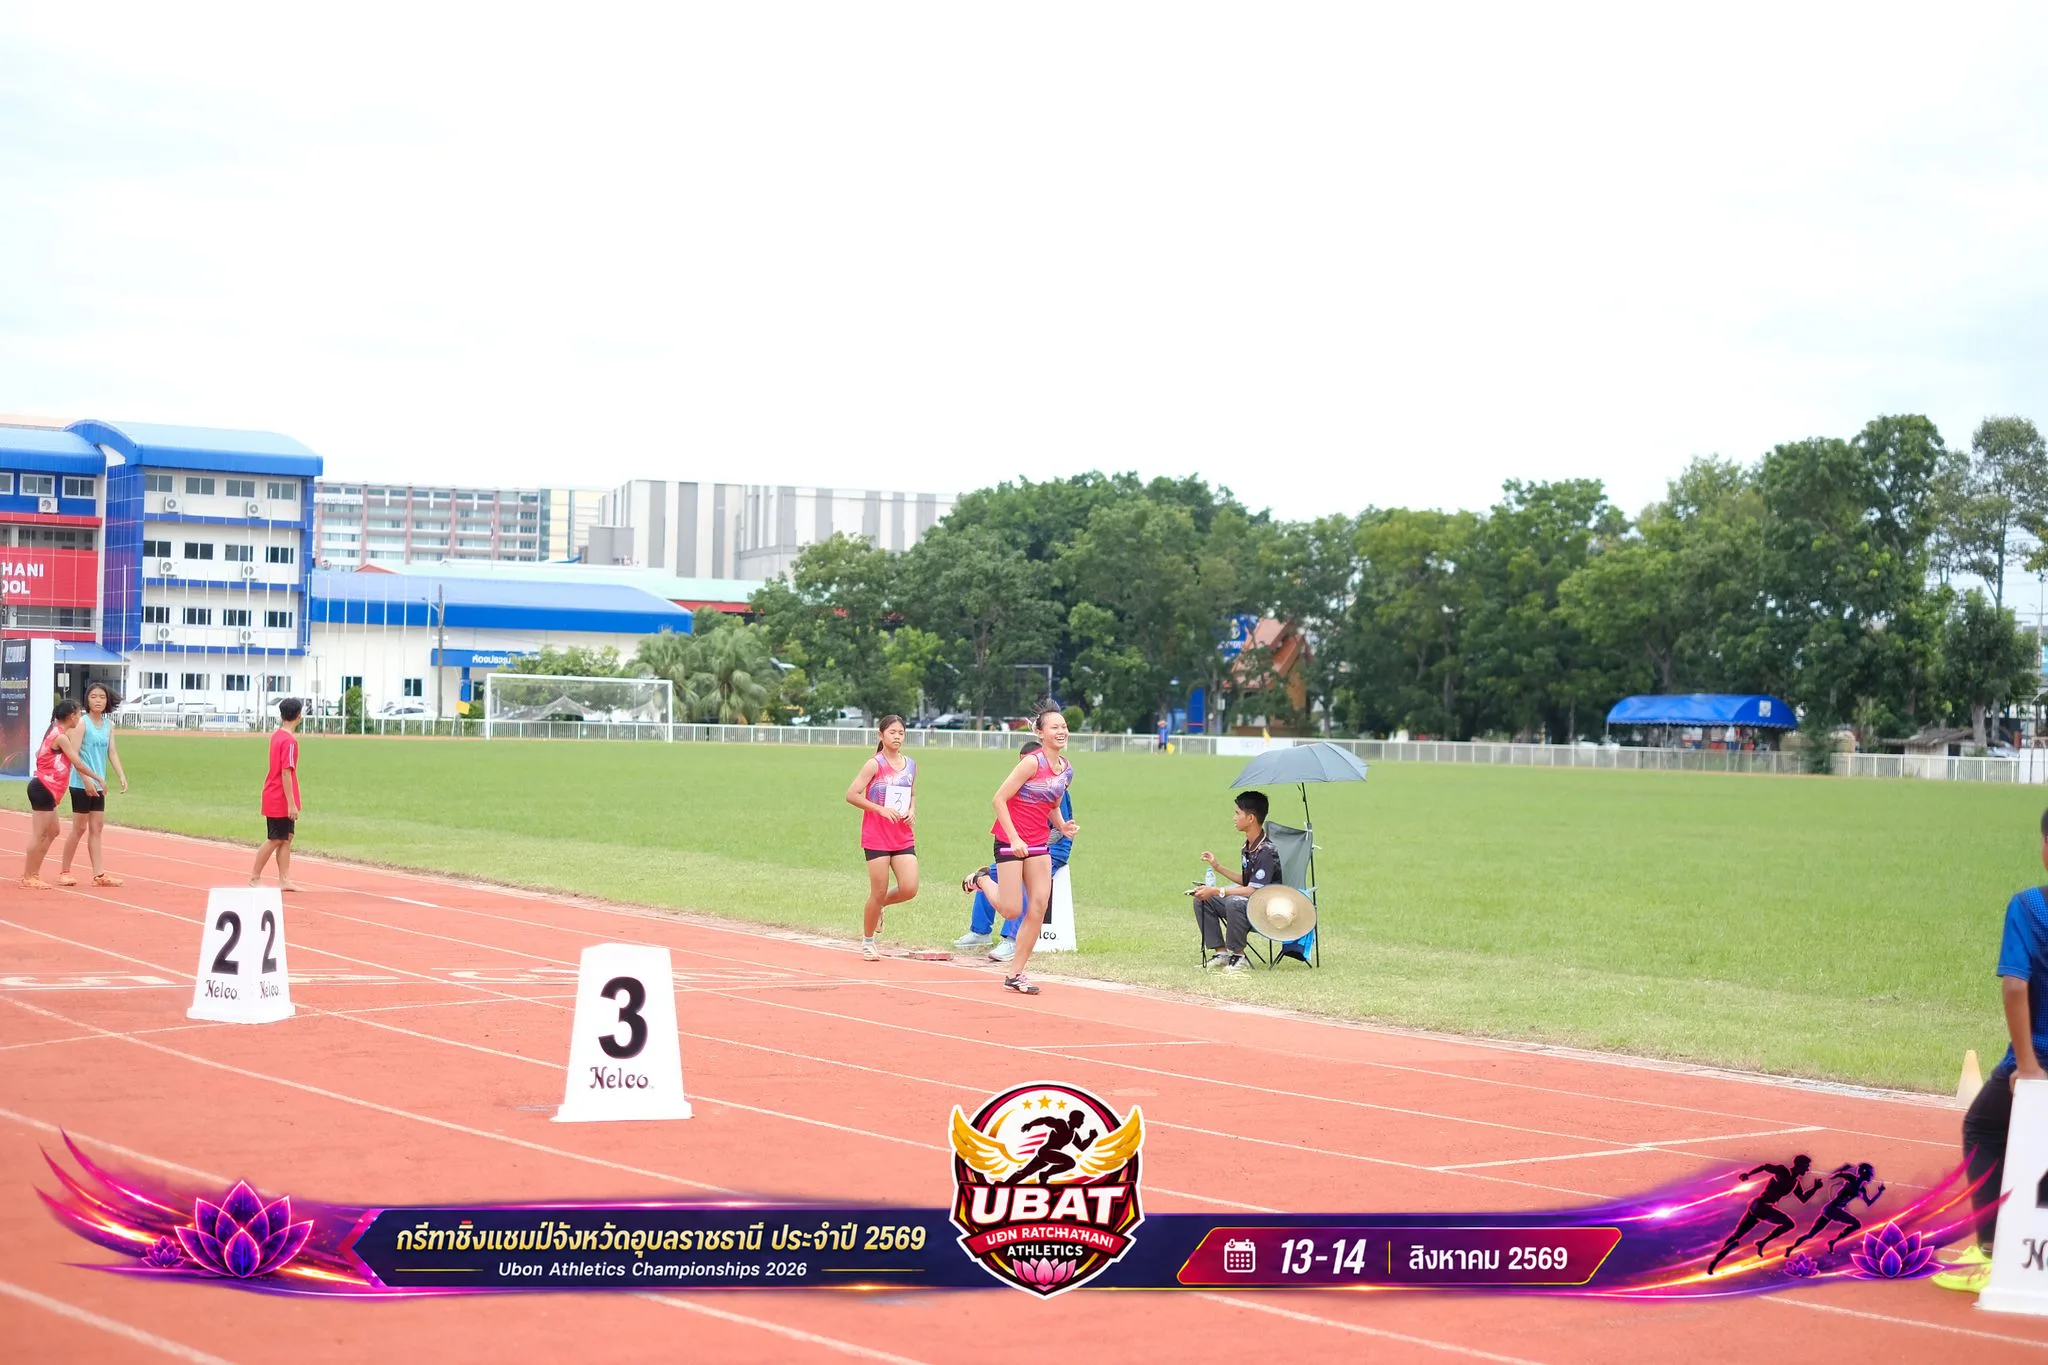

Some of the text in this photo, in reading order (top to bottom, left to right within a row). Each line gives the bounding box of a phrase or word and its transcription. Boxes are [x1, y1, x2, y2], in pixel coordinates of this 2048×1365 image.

[2, 562, 44, 577] HANI
[211, 910, 242, 975] 2
[261, 910, 277, 974] 2
[205, 979, 239, 1001] Nelco
[259, 981, 279, 999] Nelco
[598, 976, 648, 1060] 3
[589, 1066, 649, 1090] Nelco
